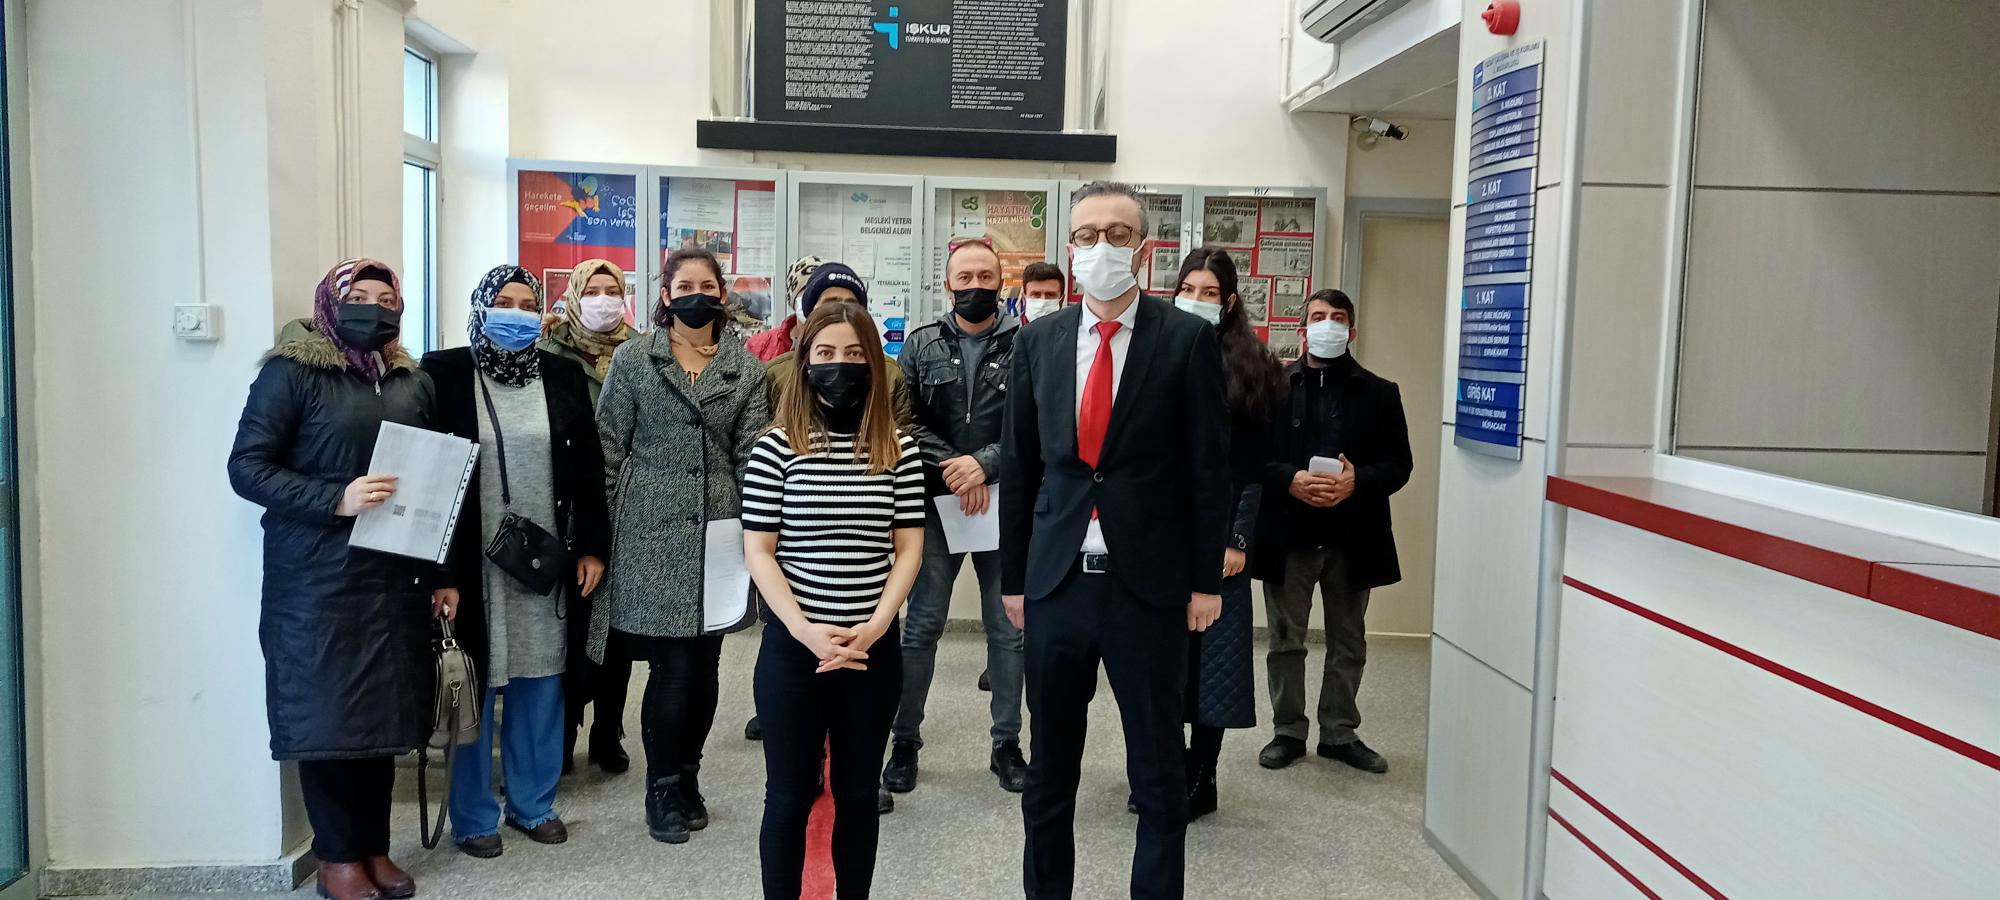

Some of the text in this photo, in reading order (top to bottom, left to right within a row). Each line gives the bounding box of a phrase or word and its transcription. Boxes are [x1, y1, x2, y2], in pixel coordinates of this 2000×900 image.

[524, 191, 562, 201] Harekete
[524, 203, 557, 212] geçelim
[586, 216, 607, 227] son
[610, 218, 636, 229] verel
[864, 216, 891, 225] MESLEKİ
[860, 226, 892, 235] BELGENİZİ
[1481, 290, 1495, 304] KAT
[1481, 387, 1496, 402] KAT
